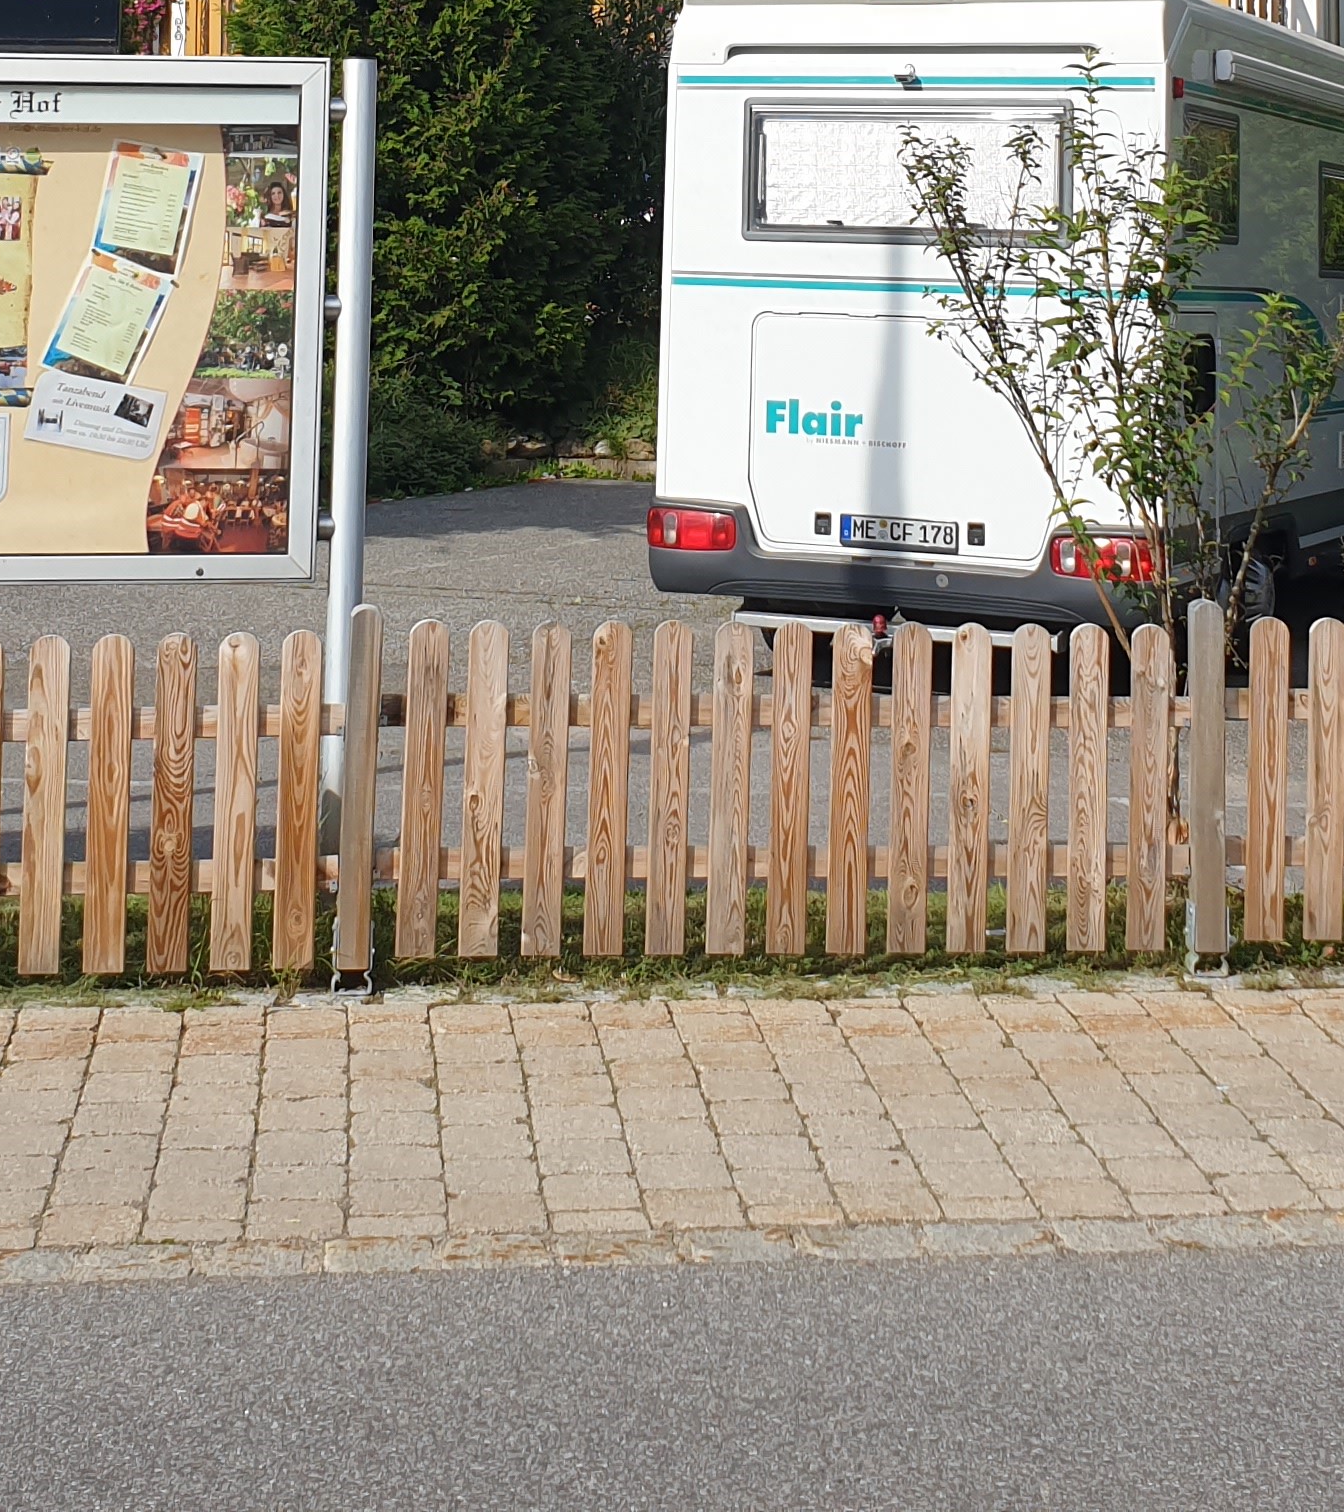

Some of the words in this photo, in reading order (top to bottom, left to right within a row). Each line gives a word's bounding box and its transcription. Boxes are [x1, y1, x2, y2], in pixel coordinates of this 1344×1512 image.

[9, 90, 63, 119] Hof
[56, 382, 106, 399] Tanzabend
[66, 397, 112, 414] Livemusik
[766, 398, 863, 437] Flair
[816, 438, 859, 446] NIESMANN
[868, 440, 907, 449] BISCHOFF
[852, 519, 877, 539] ME
[890, 522, 914, 541] CF
[918, 524, 954, 545] 178
